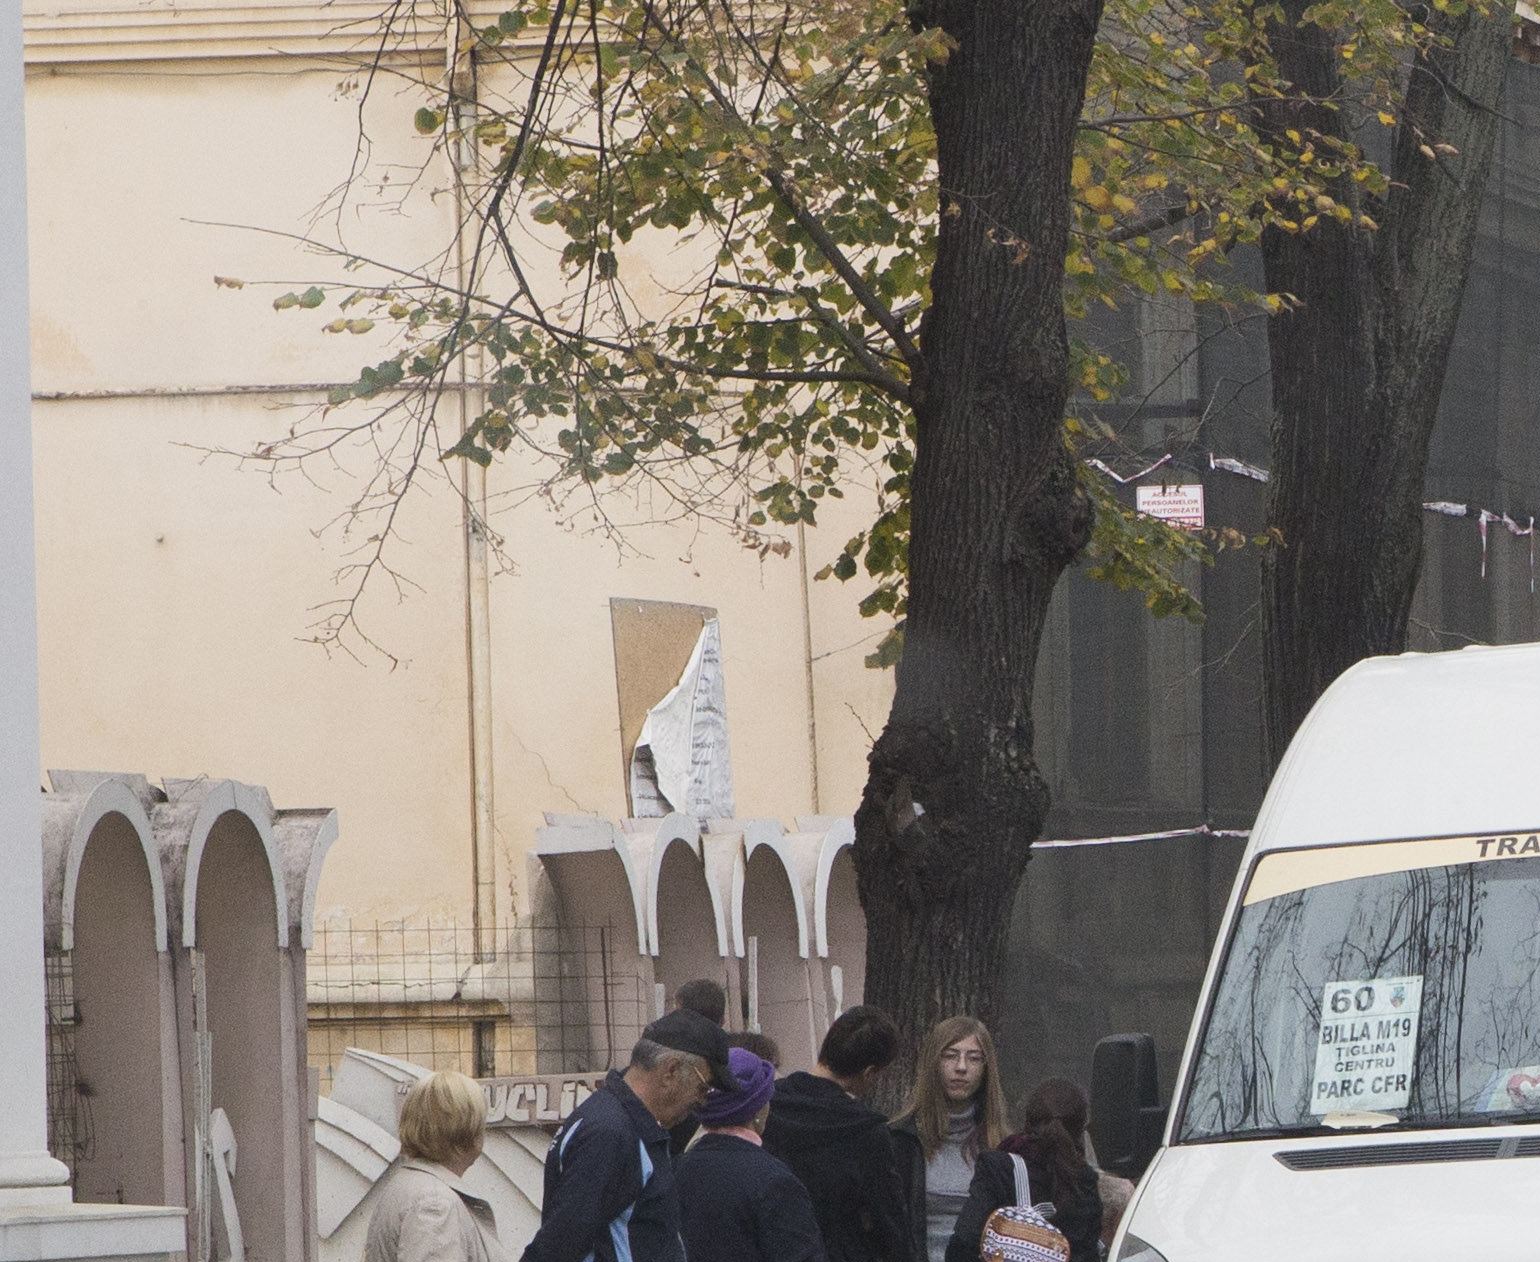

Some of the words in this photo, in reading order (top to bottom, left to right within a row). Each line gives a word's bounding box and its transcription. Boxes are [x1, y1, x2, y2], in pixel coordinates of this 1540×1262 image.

[1330, 985, 1376, 1014] 60
[1321, 1021, 1371, 1045] BILLA
[1377, 1017, 1412, 1040] M19
[1335, 1057, 1396, 1073] CENTRU
[1317, 1077, 1365, 1100] PARC
[1371, 1073, 1408, 1094] CFR
